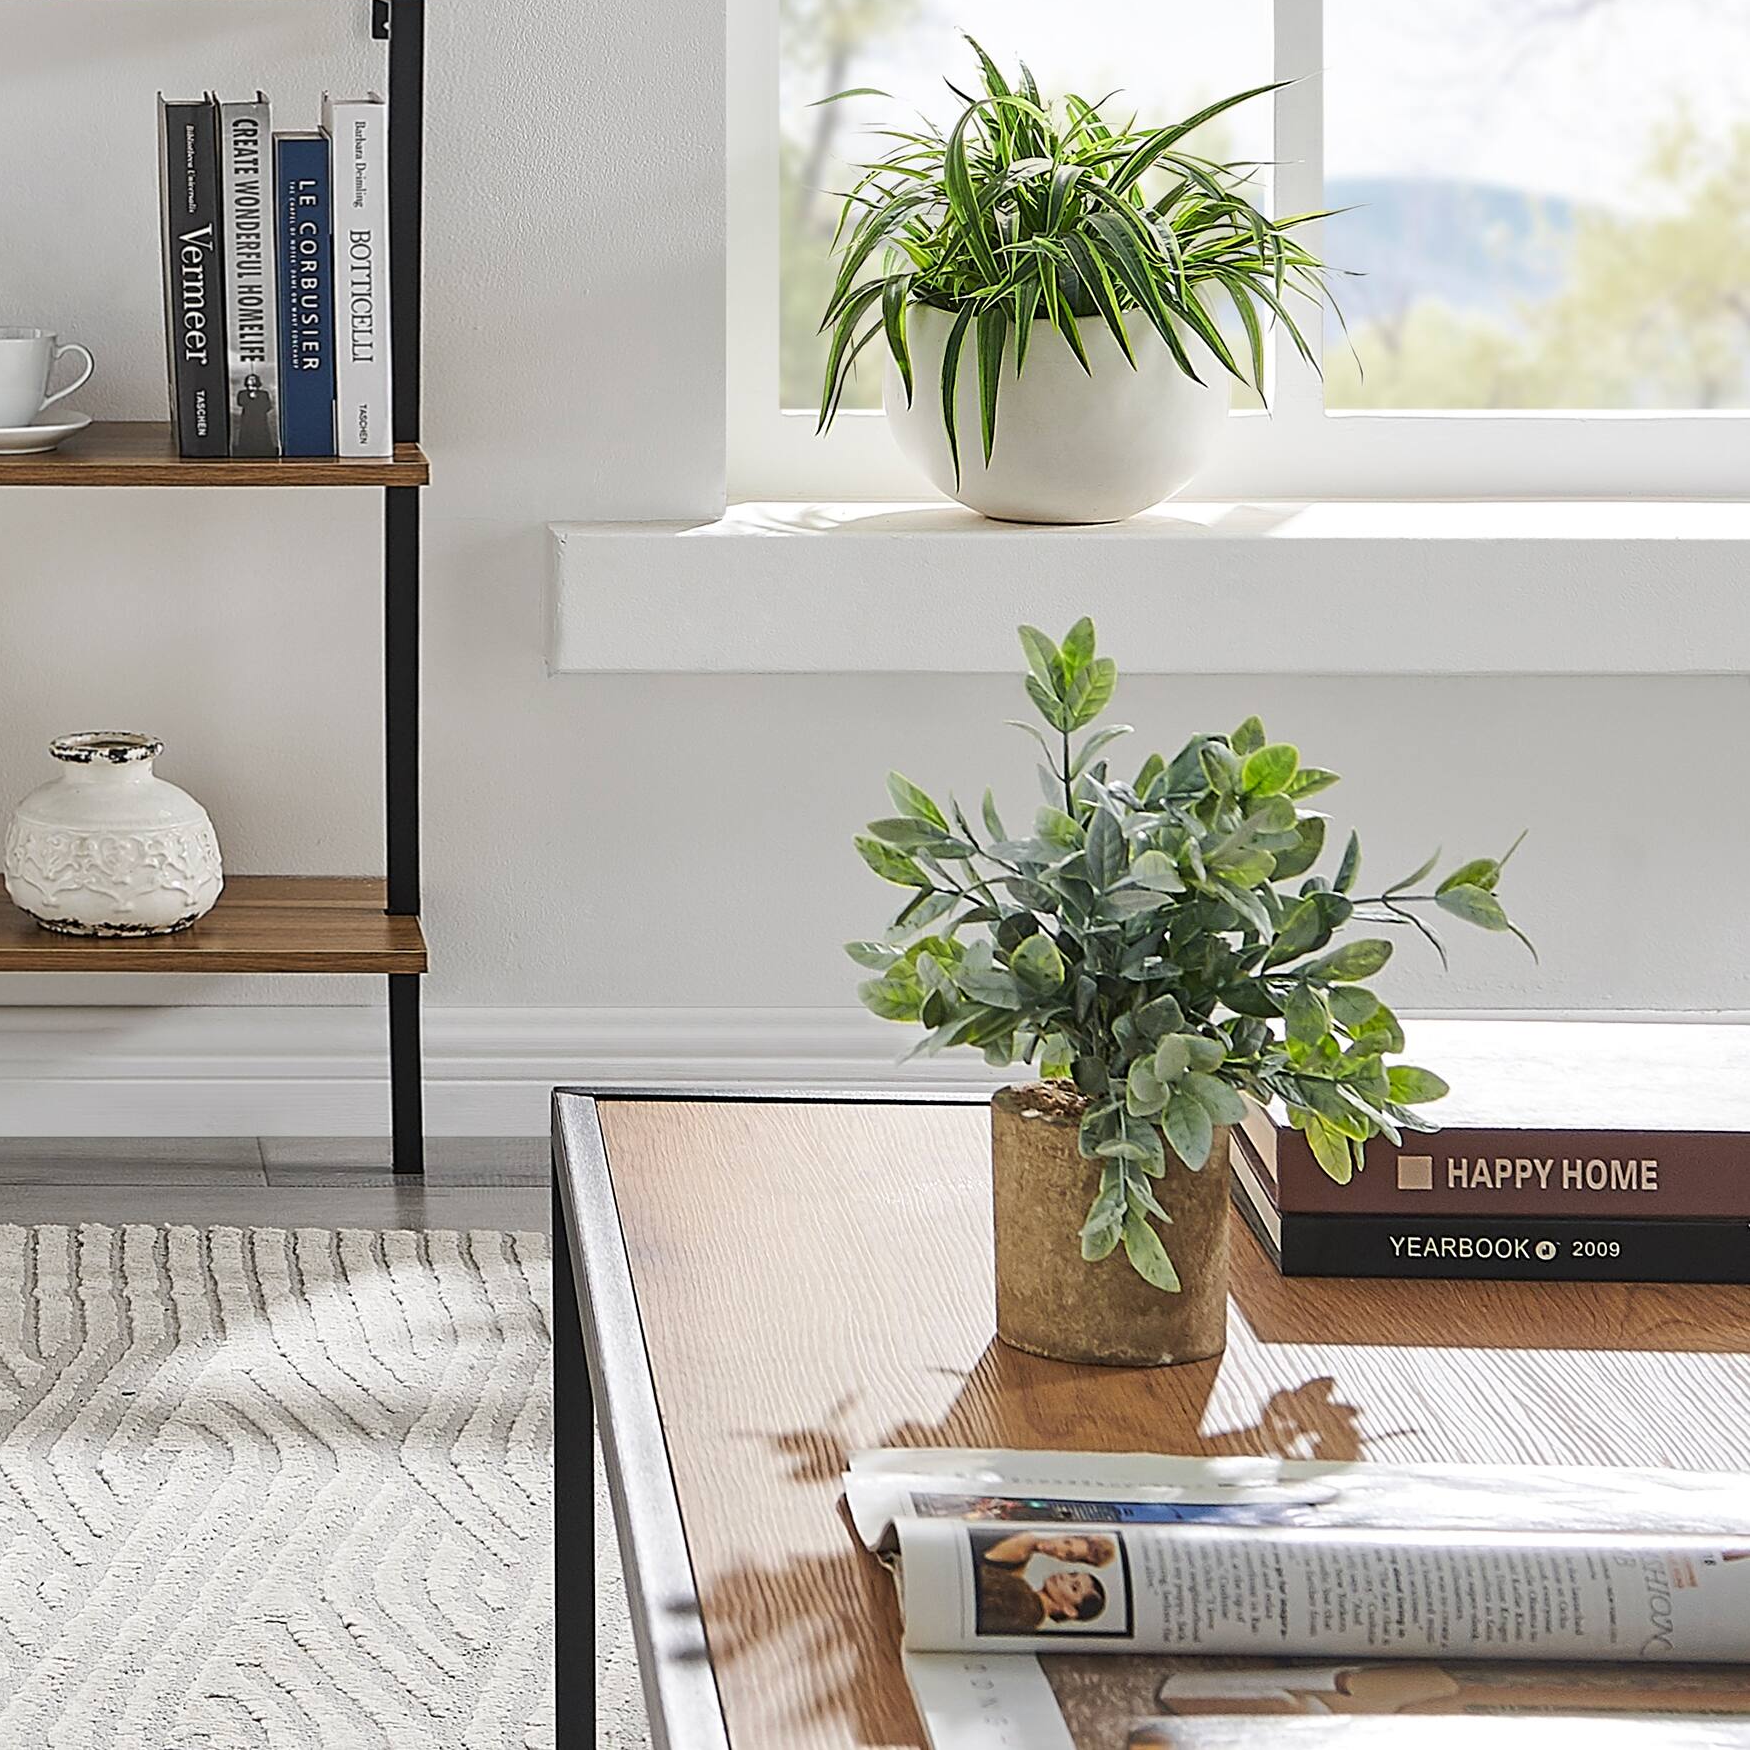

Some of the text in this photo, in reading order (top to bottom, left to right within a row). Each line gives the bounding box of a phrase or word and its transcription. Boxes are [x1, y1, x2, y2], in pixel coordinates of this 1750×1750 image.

[352, 121, 368, 208] Barbara Deimling
[232, 118, 266, 363] CREATE WONDERFUL HOMELIFE
[298, 179, 321, 371] LE CORBUSIER
[178, 223, 214, 366] Vermeer
[349, 229, 374, 364] BOTTICELLI
[195, 389, 206, 438] TASCHEN
[358, 403, 368, 445] TASCHEN
[1447, 1157, 1659, 1191] HAPPY HOME
[1389, 1235, 1621, 1260] YEARBOOK 2009
